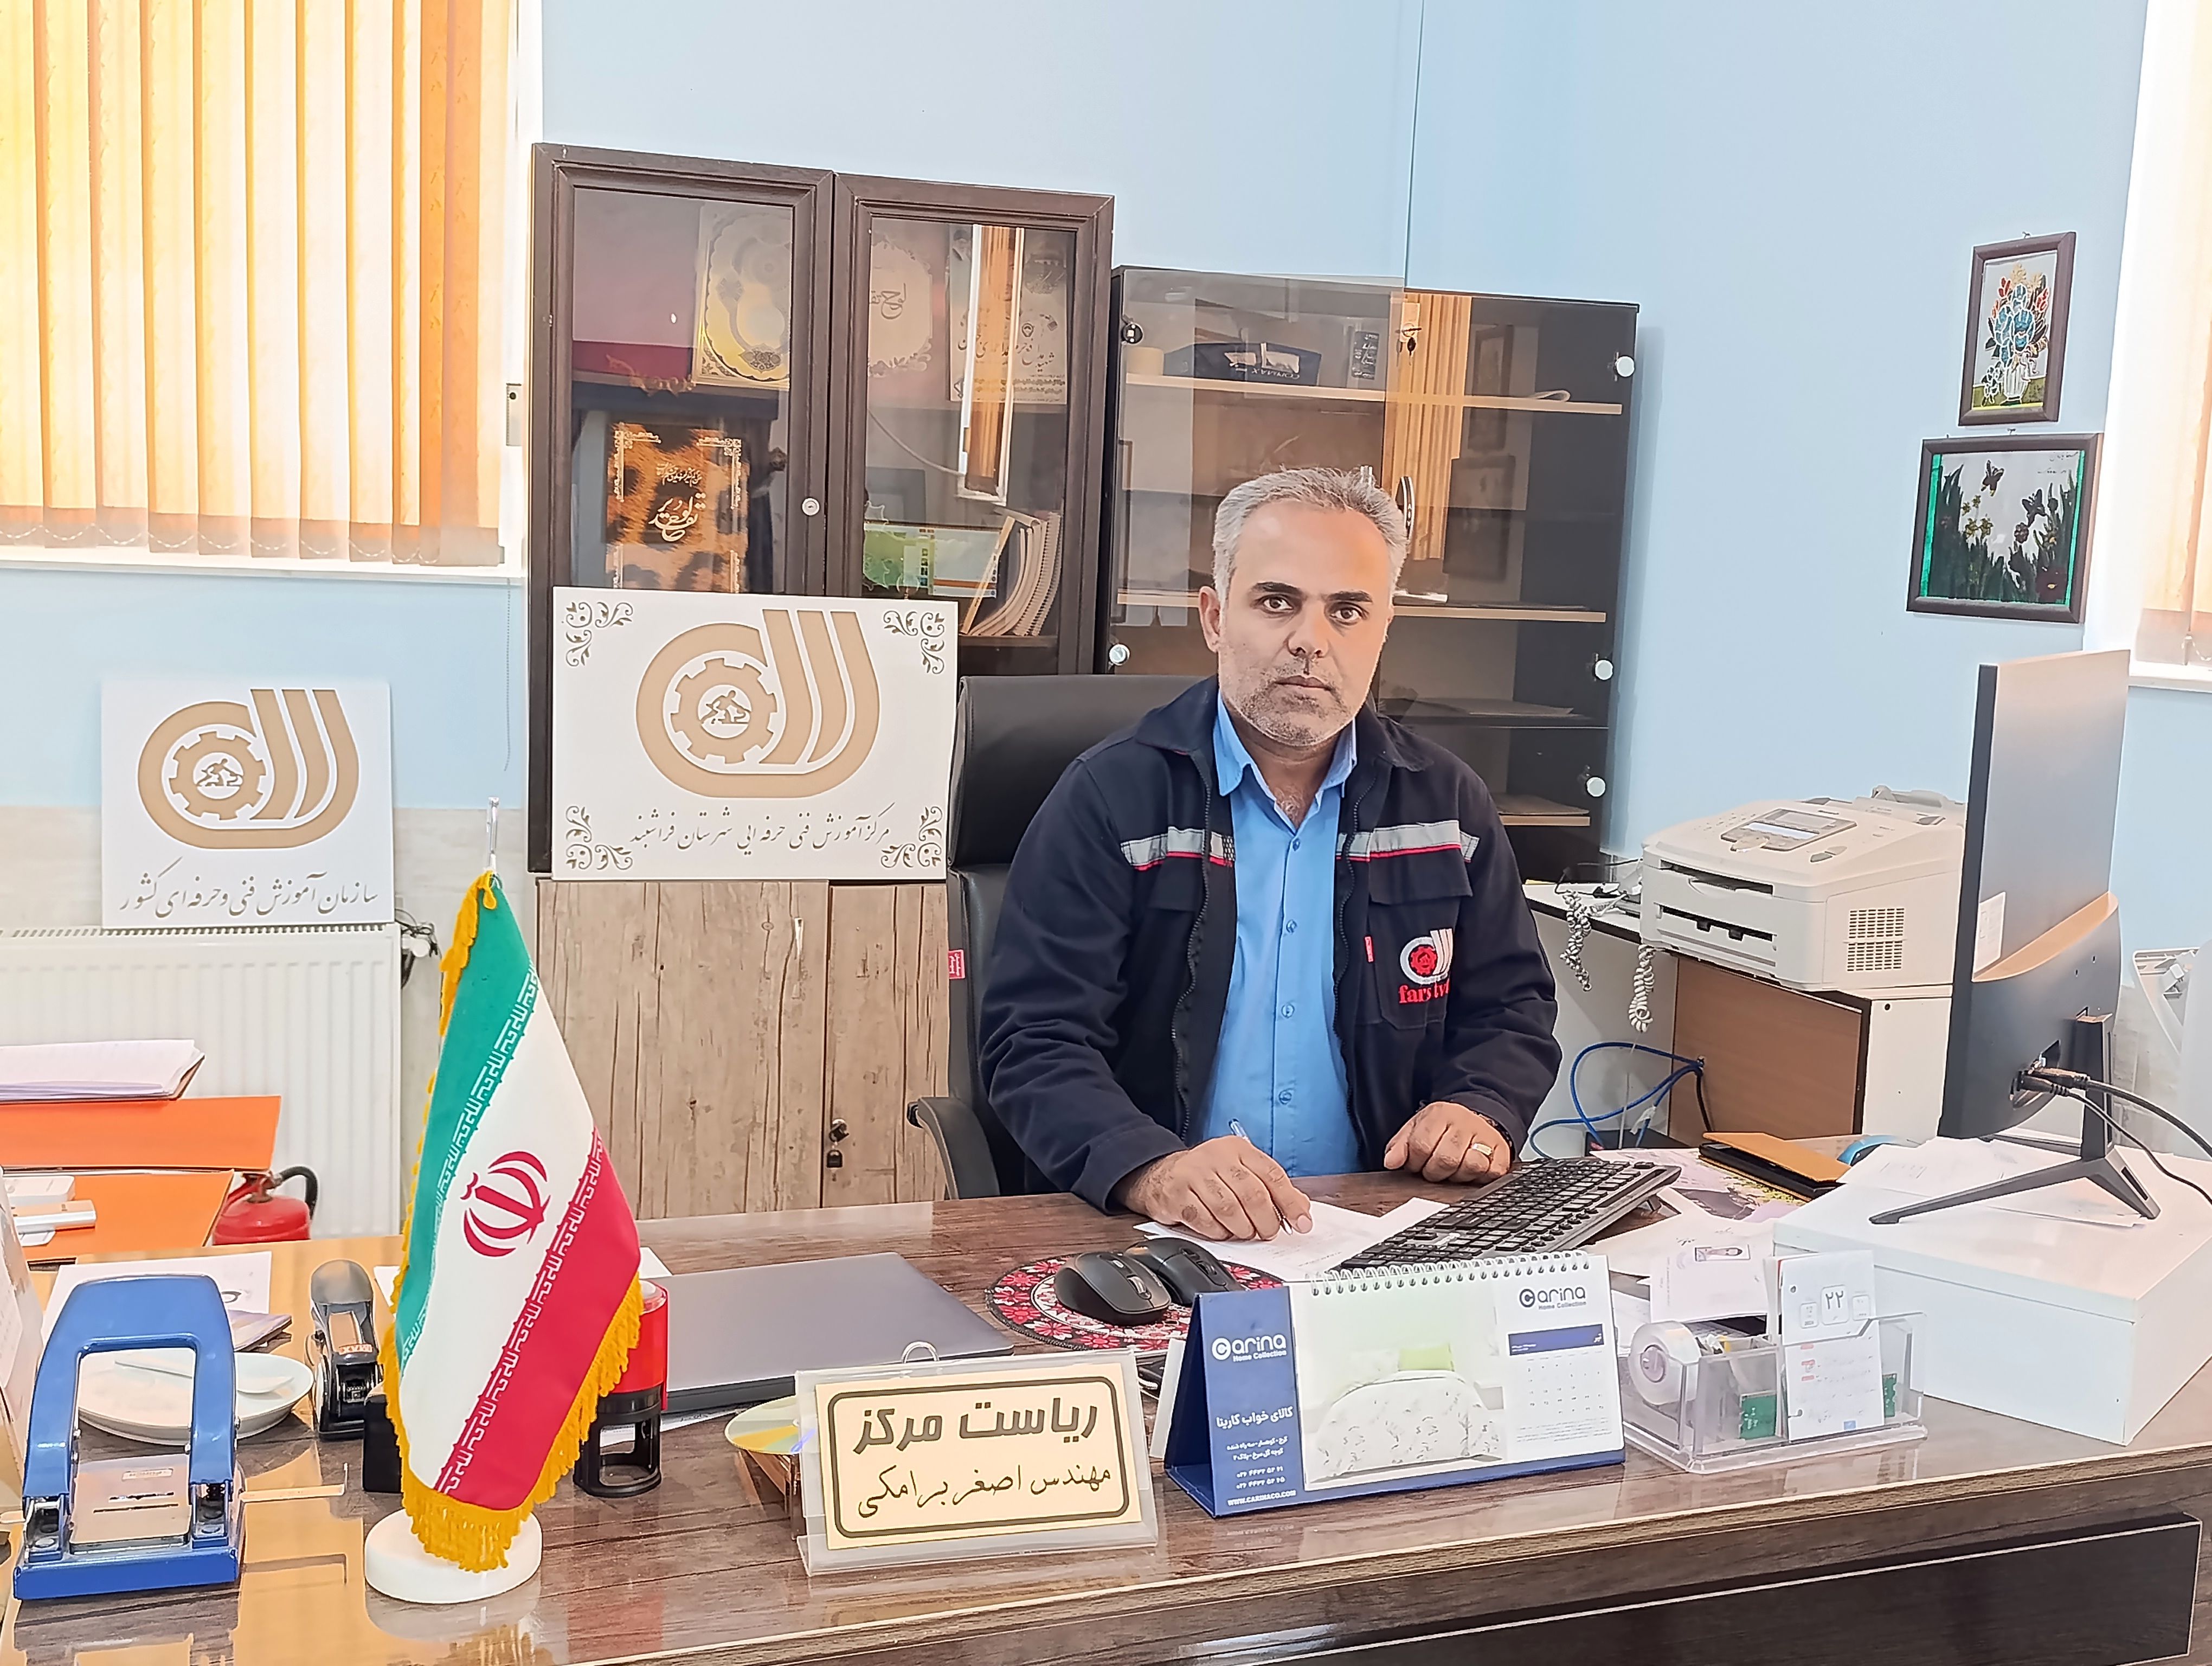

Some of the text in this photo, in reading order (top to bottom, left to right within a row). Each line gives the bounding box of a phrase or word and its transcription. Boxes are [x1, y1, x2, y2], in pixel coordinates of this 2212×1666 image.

[880, 283, 906, 319] لوح
[629, 809, 675, 848] فراشبند
[678, 806, 732, 850] شهرستان
[760, 816, 786, 842] حرفه
[789, 812, 810, 849] فنی
[812, 813, 871, 849] آموزش
[864, 802, 895, 844] مرکز
[119, 857, 182, 911] کشور
[229, 876, 255, 917] فنی
[256, 872, 327, 916] آموزش
[318, 882, 378, 914] سازمان
[1399, 985, 1432, 1003] fars
[1519, 1286, 1586, 1308] Carina
[1825, 1290, 1844, 1310] ۲۲
[1211, 1334, 1287, 1361] Carina
[1253, 1350, 1287, 1360] Collection
[853, 1398, 1098, 1455] ریاست مرکز
[1216, 1406, 1293, 1429] کالای خواب کارینا
[858, 1464, 1111, 1518] مهندس اصغر برامکی
